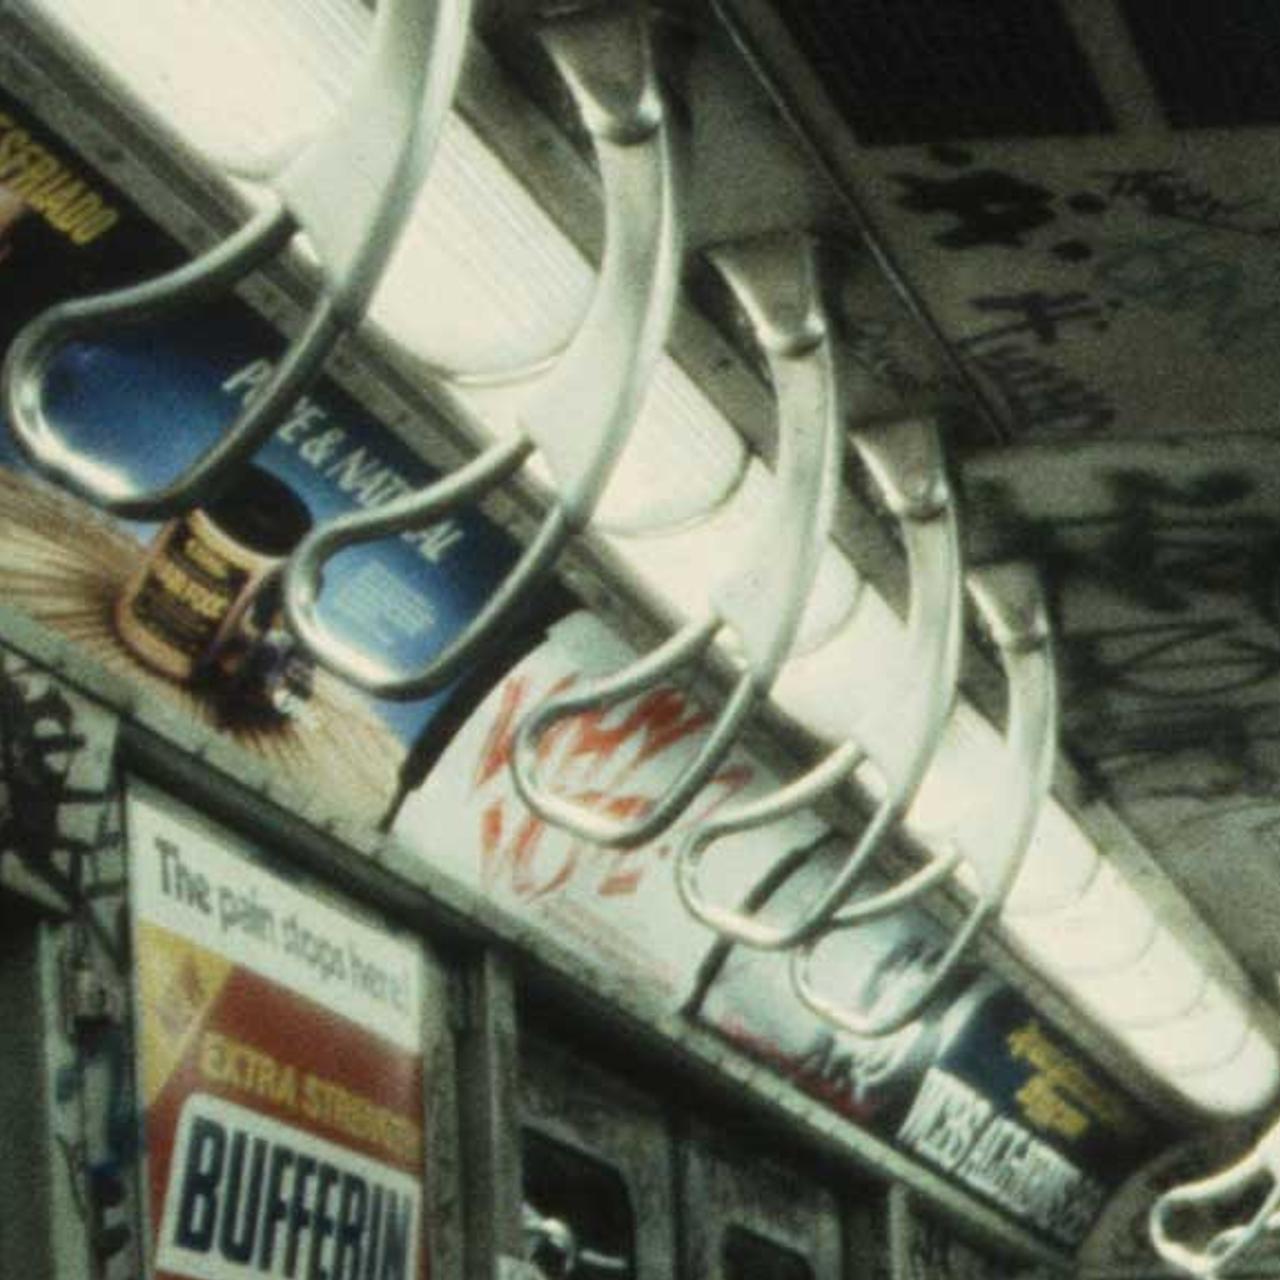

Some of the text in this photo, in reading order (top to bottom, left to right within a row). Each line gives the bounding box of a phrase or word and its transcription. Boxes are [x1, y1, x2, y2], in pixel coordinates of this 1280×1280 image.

[299, 427, 346, 466] &
[155, 836, 212, 916] The
[217, 884, 276, 946] pain
[282, 914, 347, 982] stops
